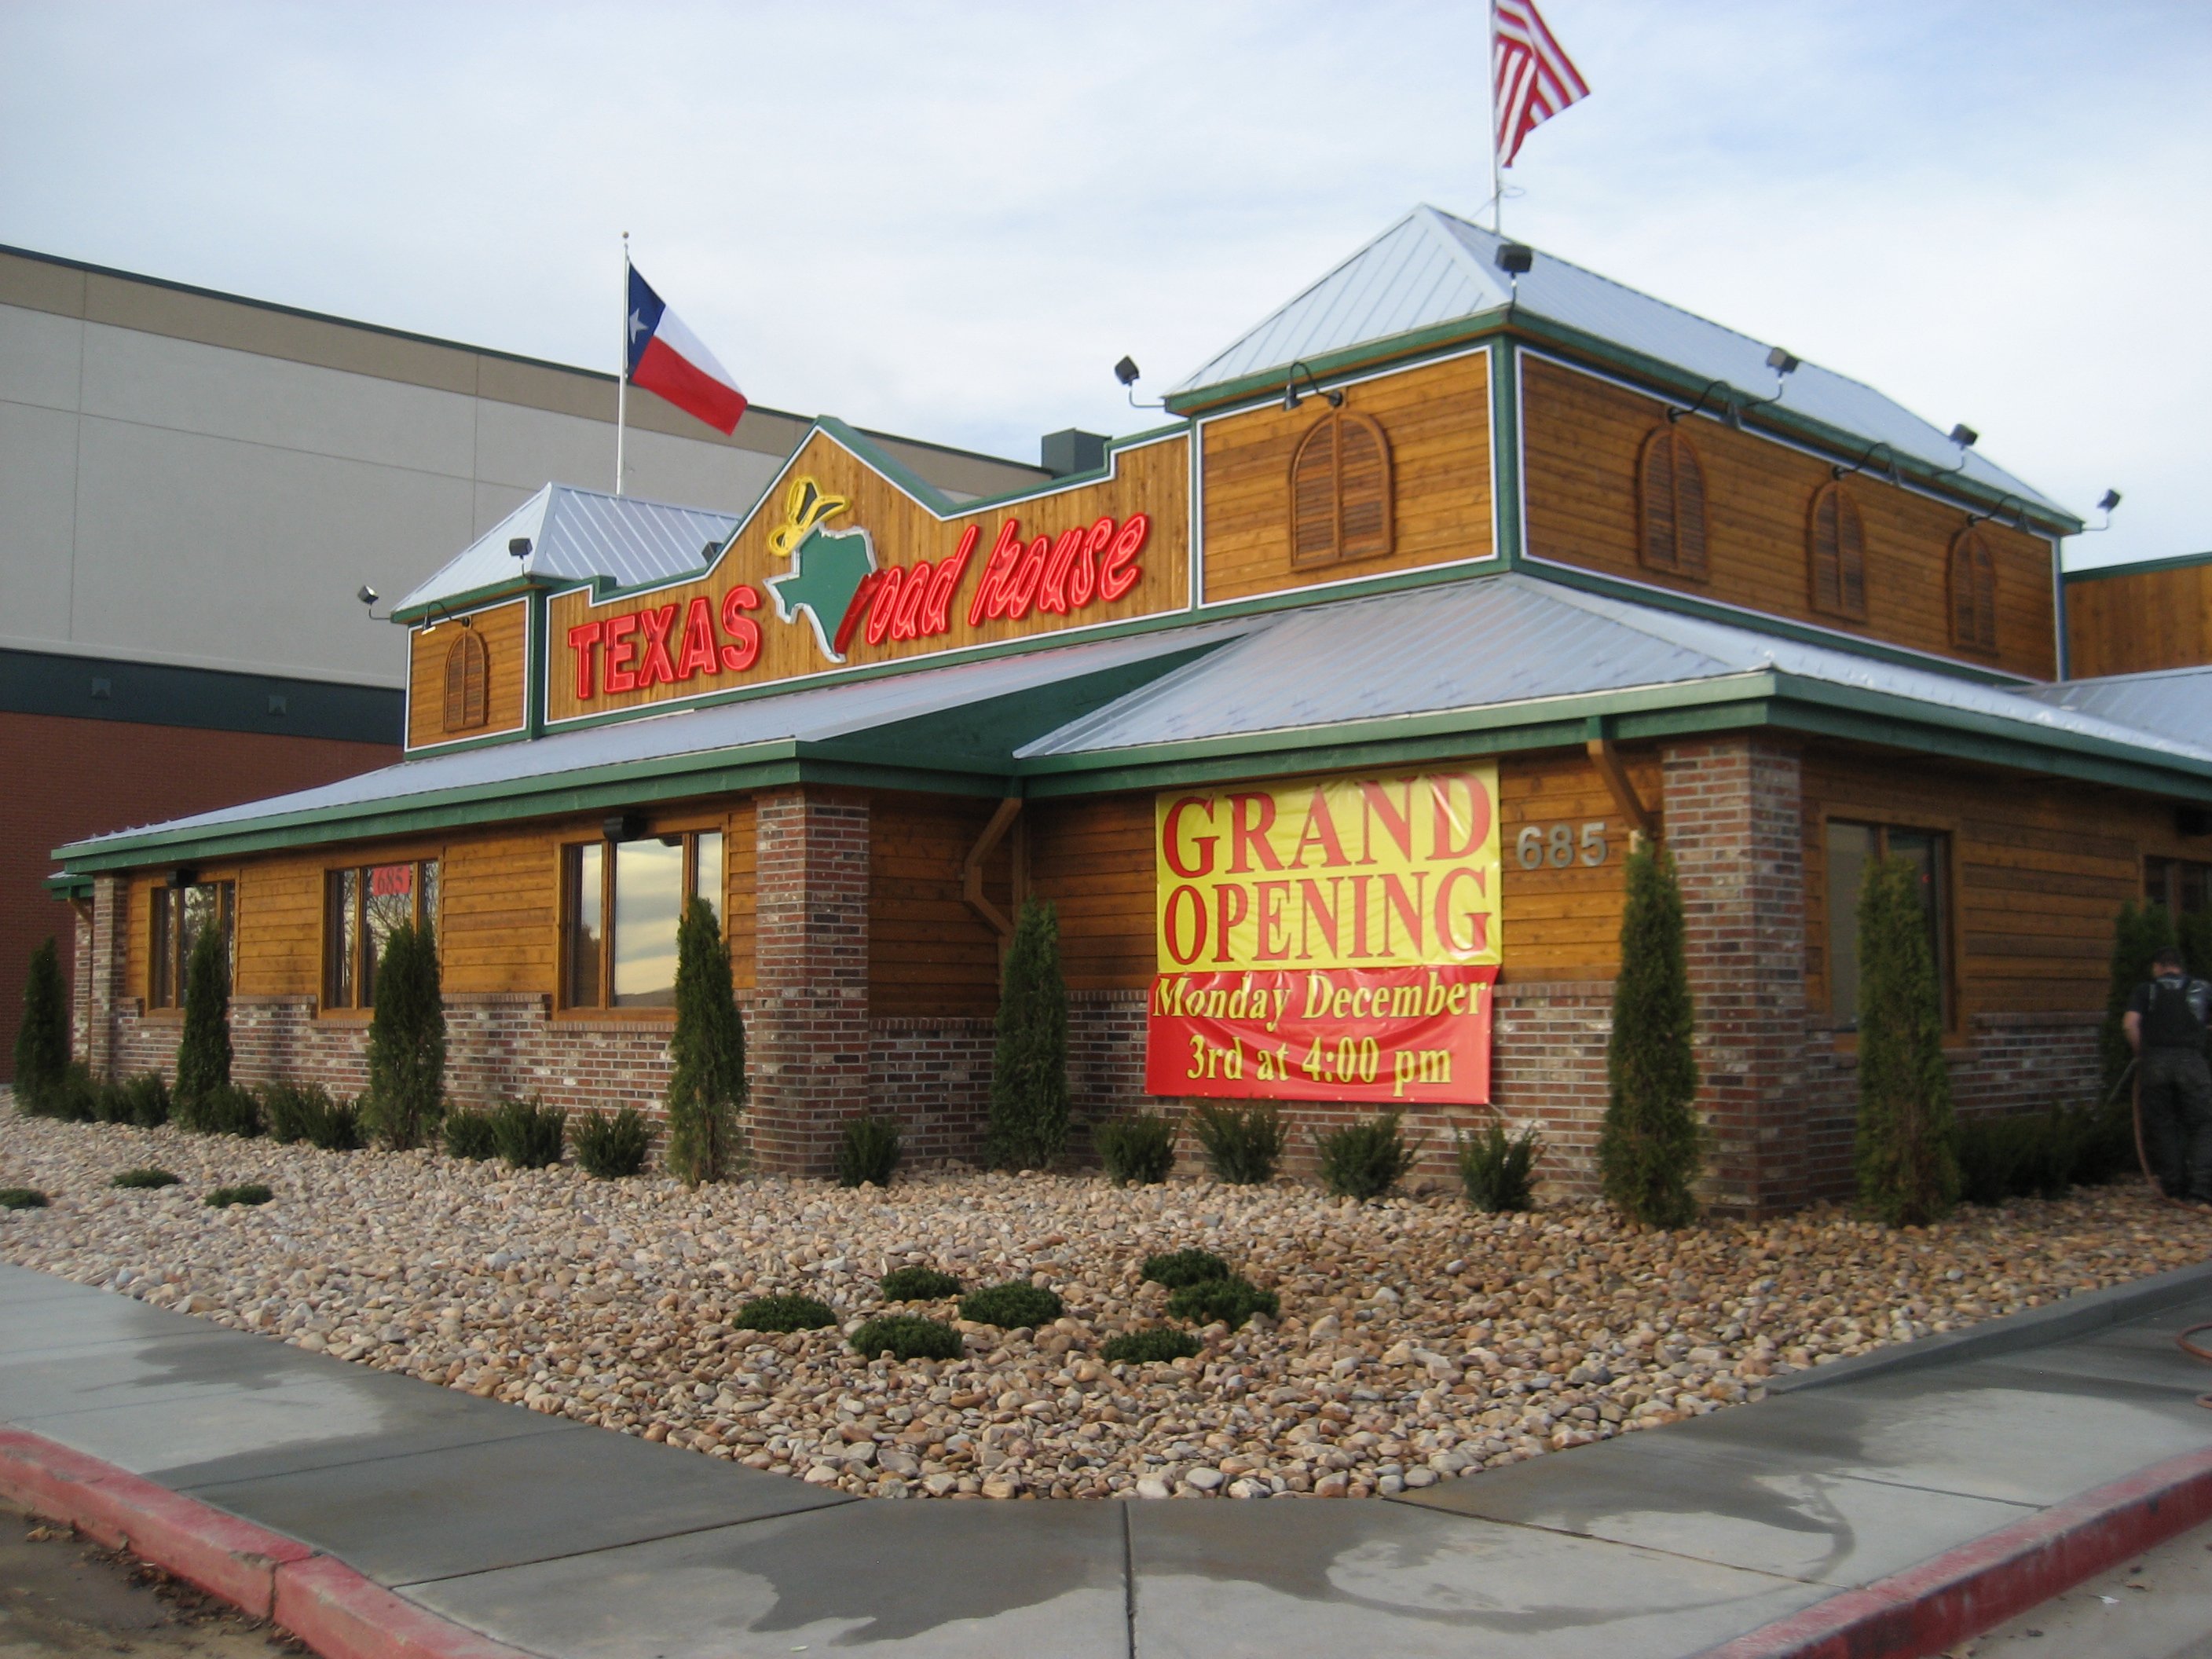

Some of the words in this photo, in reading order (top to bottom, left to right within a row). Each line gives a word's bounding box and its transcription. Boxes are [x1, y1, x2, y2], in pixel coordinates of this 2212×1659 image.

[568, 585, 762, 700] TEXAS
[969, 512, 1149, 626] house
[1163, 772, 1491, 877] GRAND
[1516, 822, 1607, 870] 685
[1164, 867, 1492, 965] OPENING
[1152, 976, 1291, 1031] Monday
[1302, 972, 1486, 1019] December
[1187, 1035, 1244, 1081] 3rd
[1257, 1044, 1289, 1081] at
[1302, 1036, 1379, 1083] 4:00
[1393, 1048, 1451, 1097] pm
